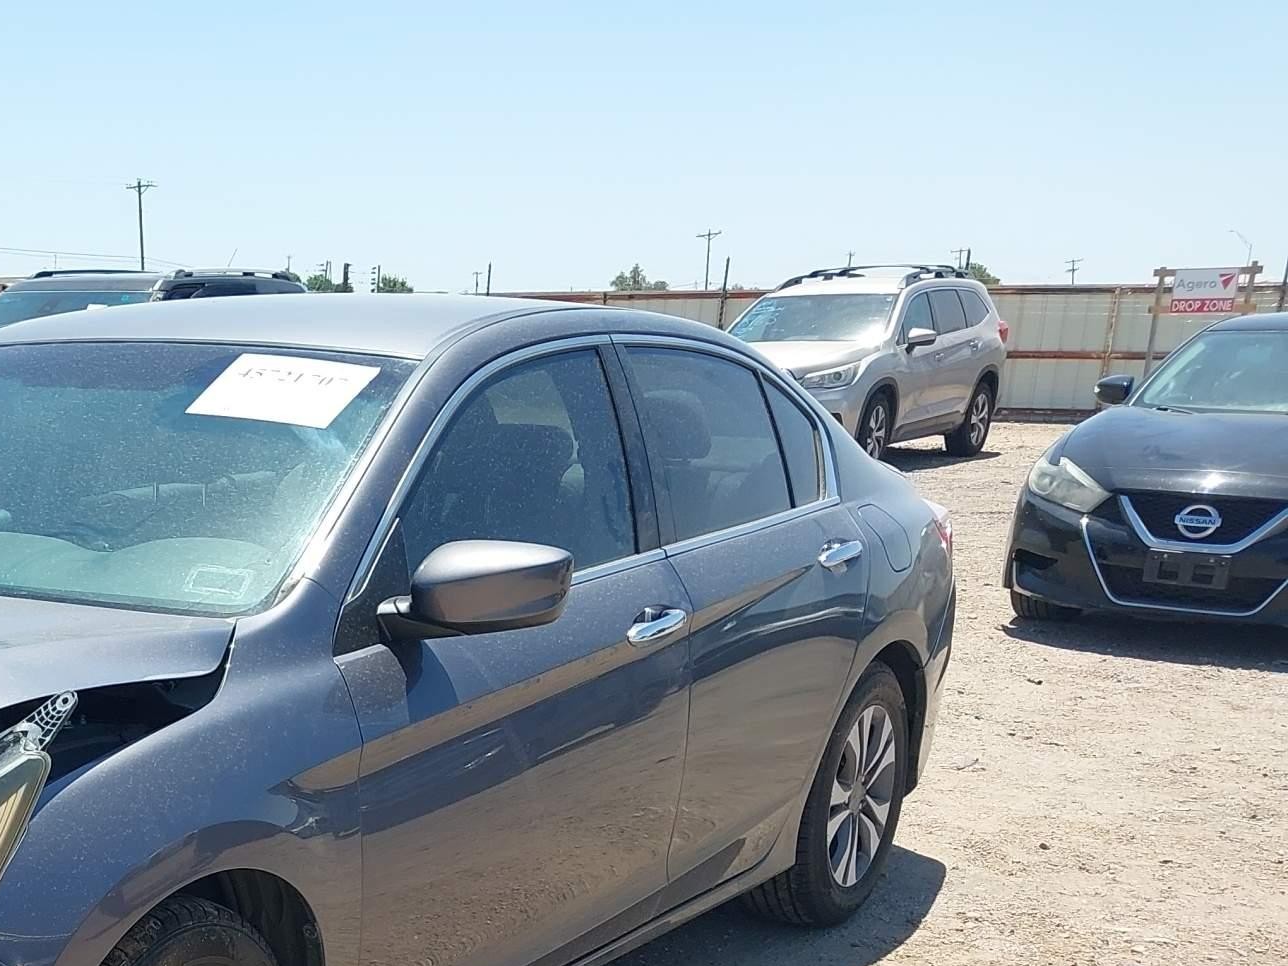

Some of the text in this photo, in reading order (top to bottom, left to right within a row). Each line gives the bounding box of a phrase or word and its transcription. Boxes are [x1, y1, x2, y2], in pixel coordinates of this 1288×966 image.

[1176, 279, 1217, 292] Agero
[1171, 299, 1233, 312] DROP ZONE
[1178, 516, 1216, 526] NISSAN
